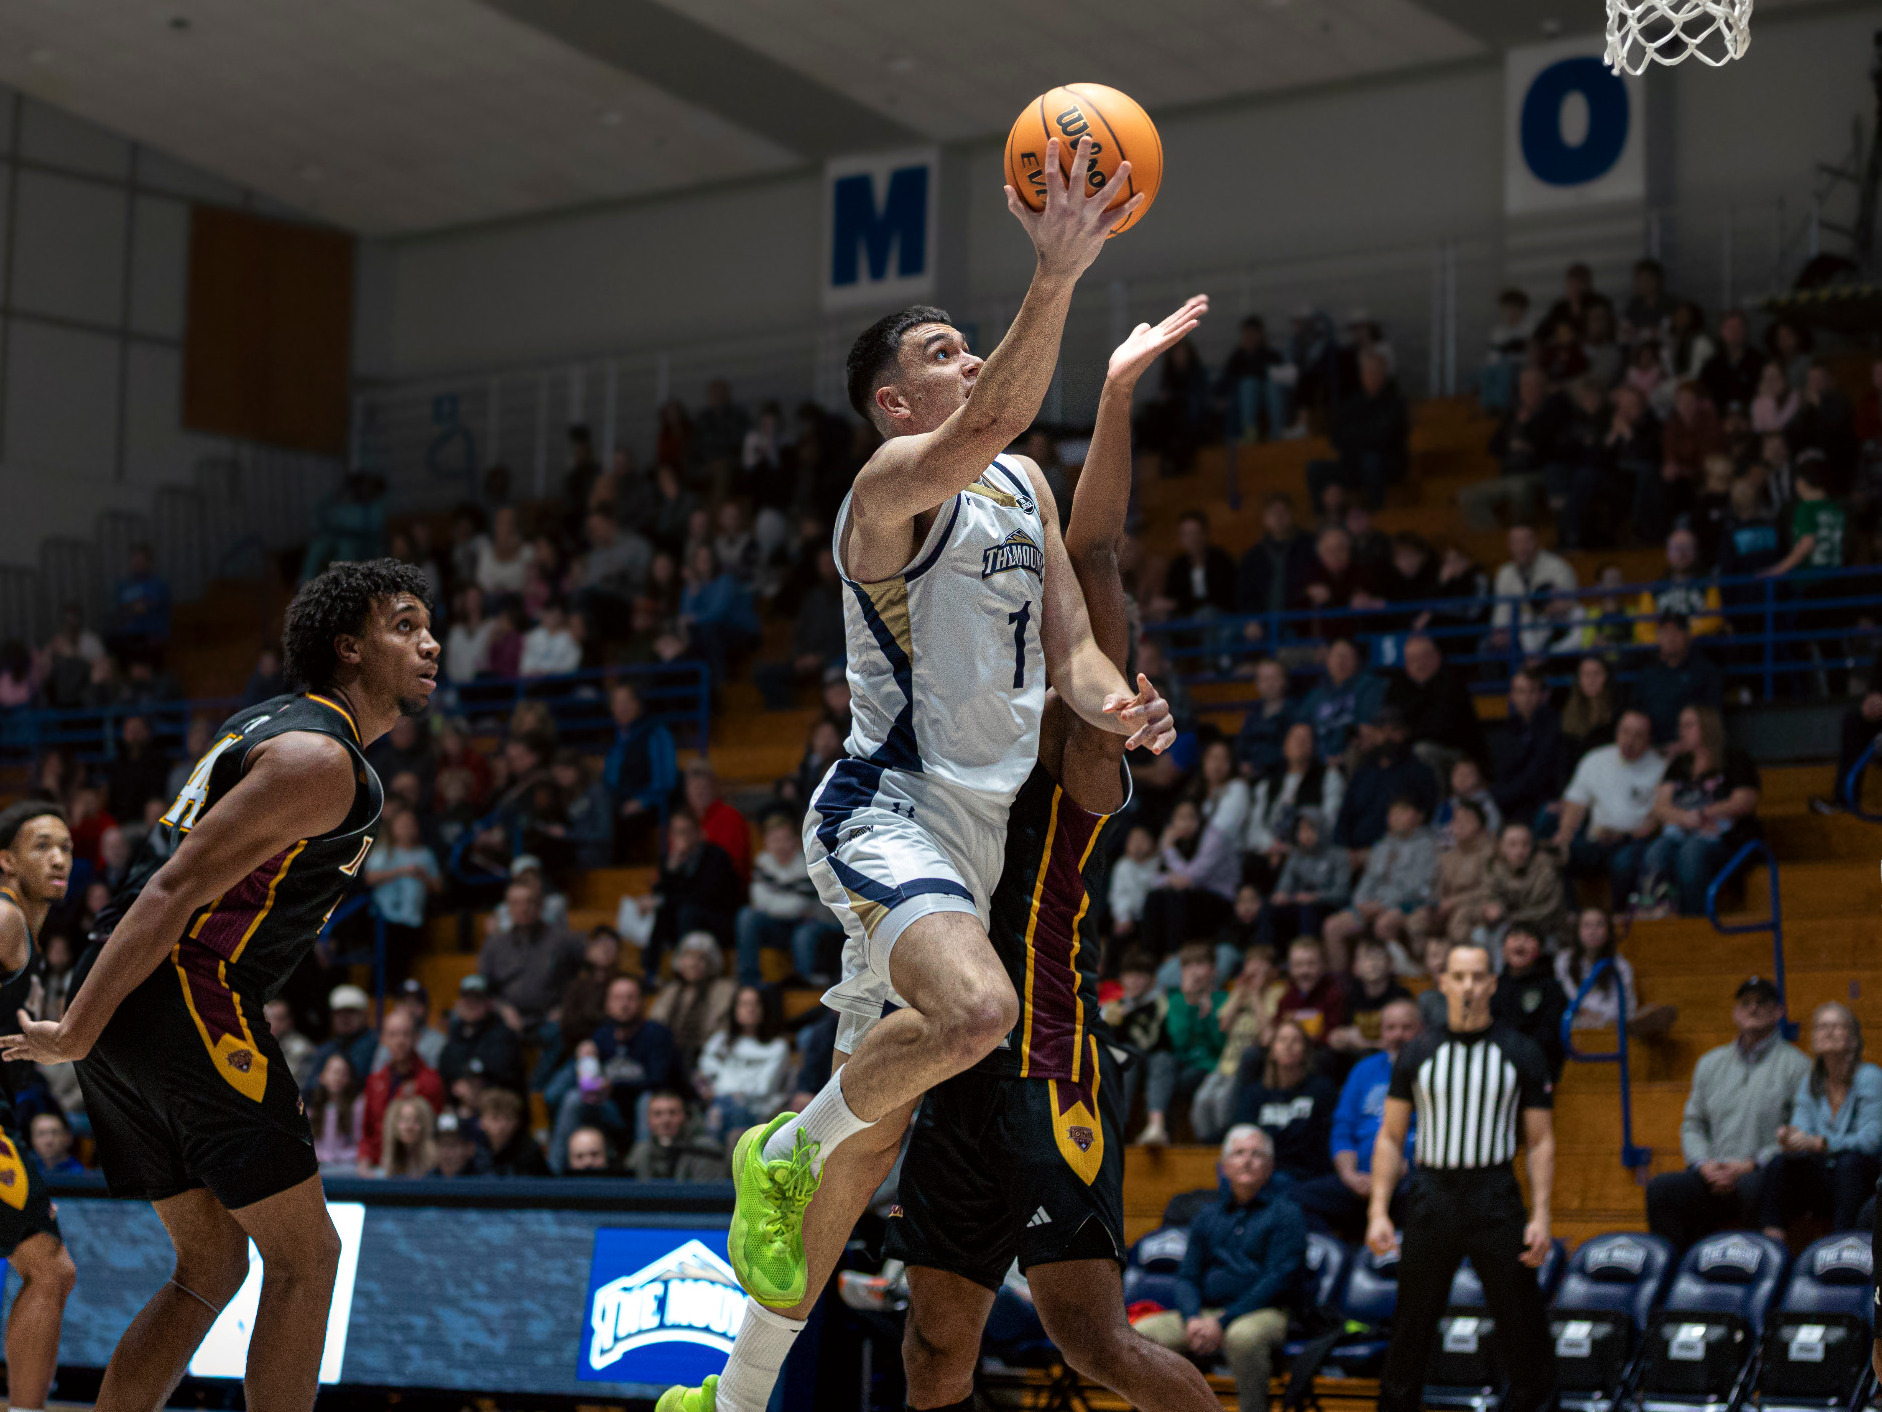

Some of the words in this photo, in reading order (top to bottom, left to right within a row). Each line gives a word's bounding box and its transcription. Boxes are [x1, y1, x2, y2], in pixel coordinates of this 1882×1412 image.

[1520, 56, 1629, 186] O
[833, 166, 928, 286] M
[1008, 601, 1032, 688] 1
